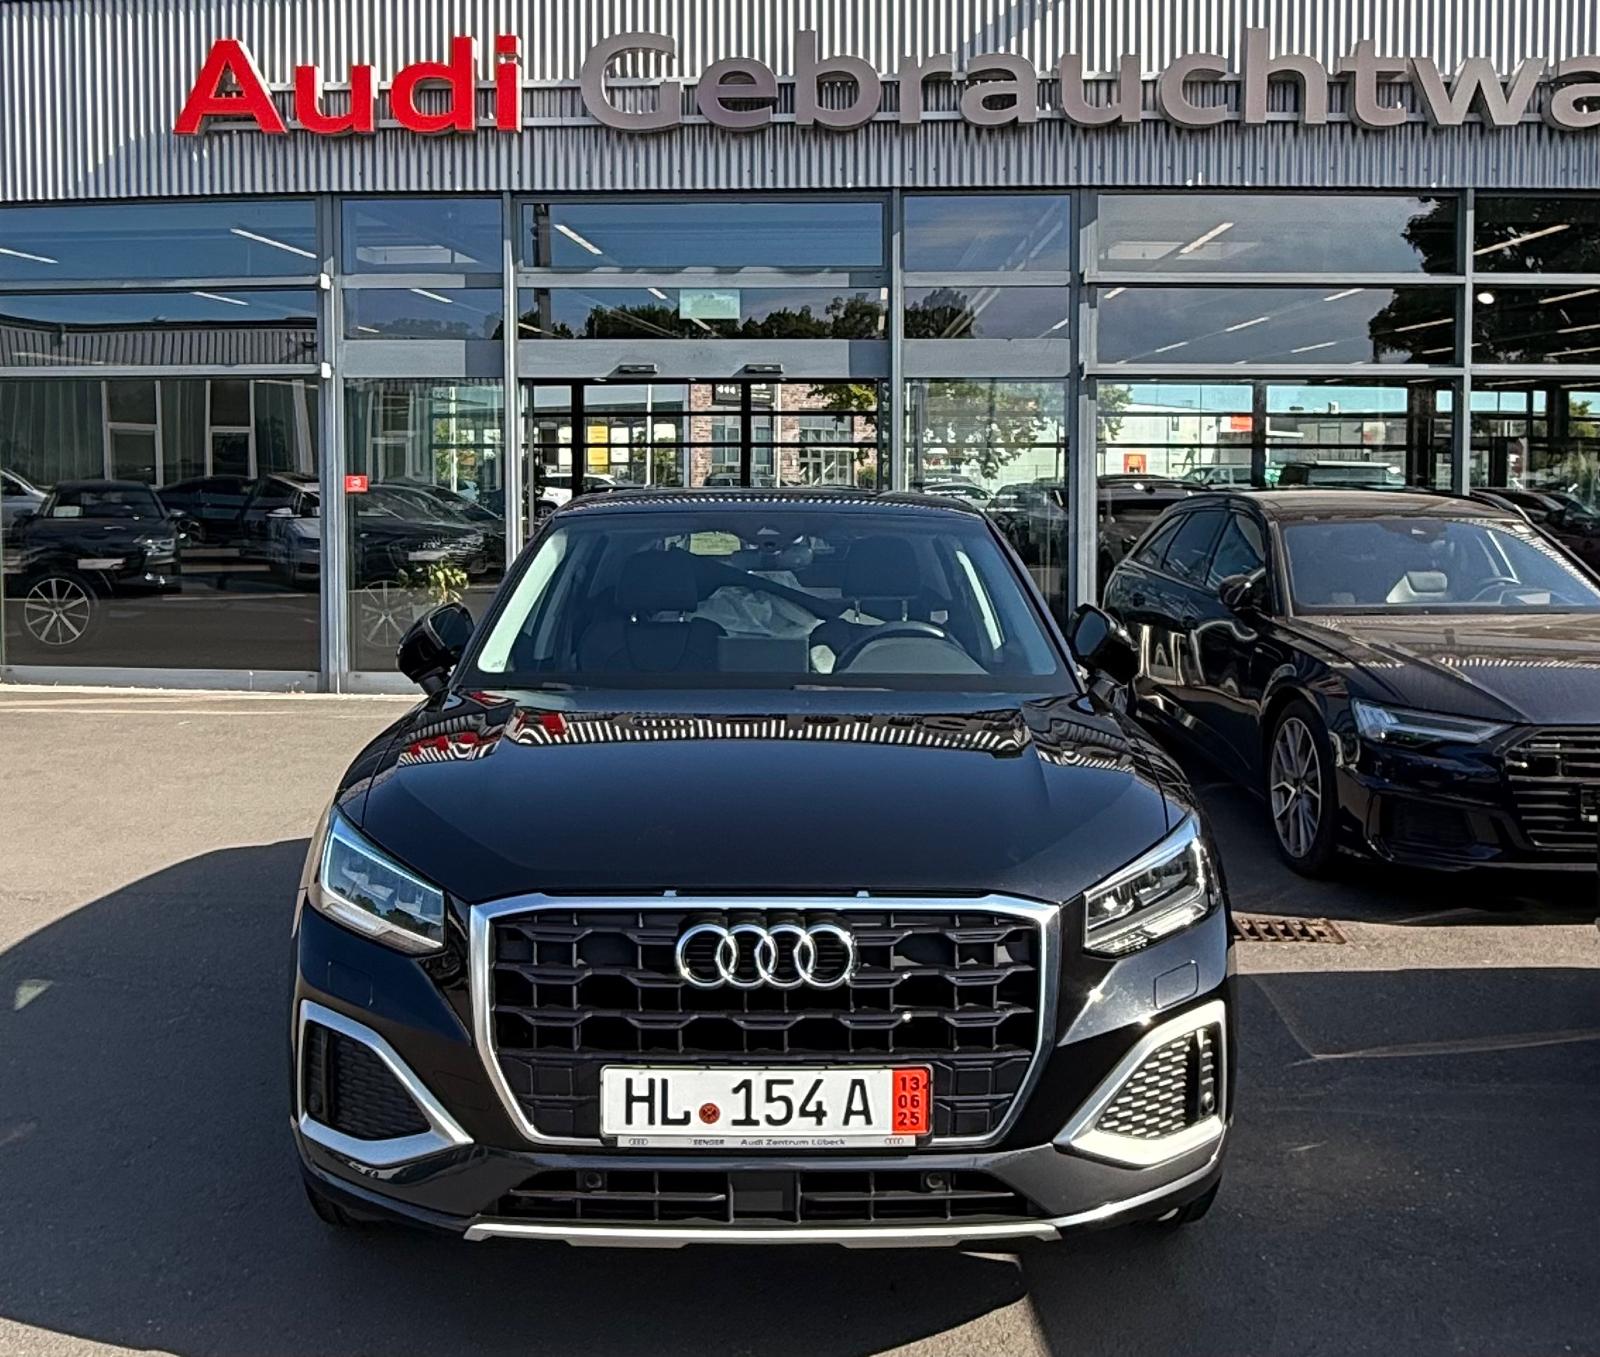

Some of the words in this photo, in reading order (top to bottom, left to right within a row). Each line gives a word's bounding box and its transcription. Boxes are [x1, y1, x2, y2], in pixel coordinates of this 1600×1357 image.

[172, 35, 522, 136] Audi
[899, 1076, 920, 1091] 13
[624, 1077, 692, 1126] HL
[731, 1078, 827, 1127] 154
[842, 1078, 873, 1126] A
[897, 1094, 920, 1109] 06
[897, 1111, 920, 1126] 25
[740, 1138, 763, 1146] Audi
[765, 1138, 809, 1146] Zentrum
[811, 1137, 846, 1146] Lübeck
